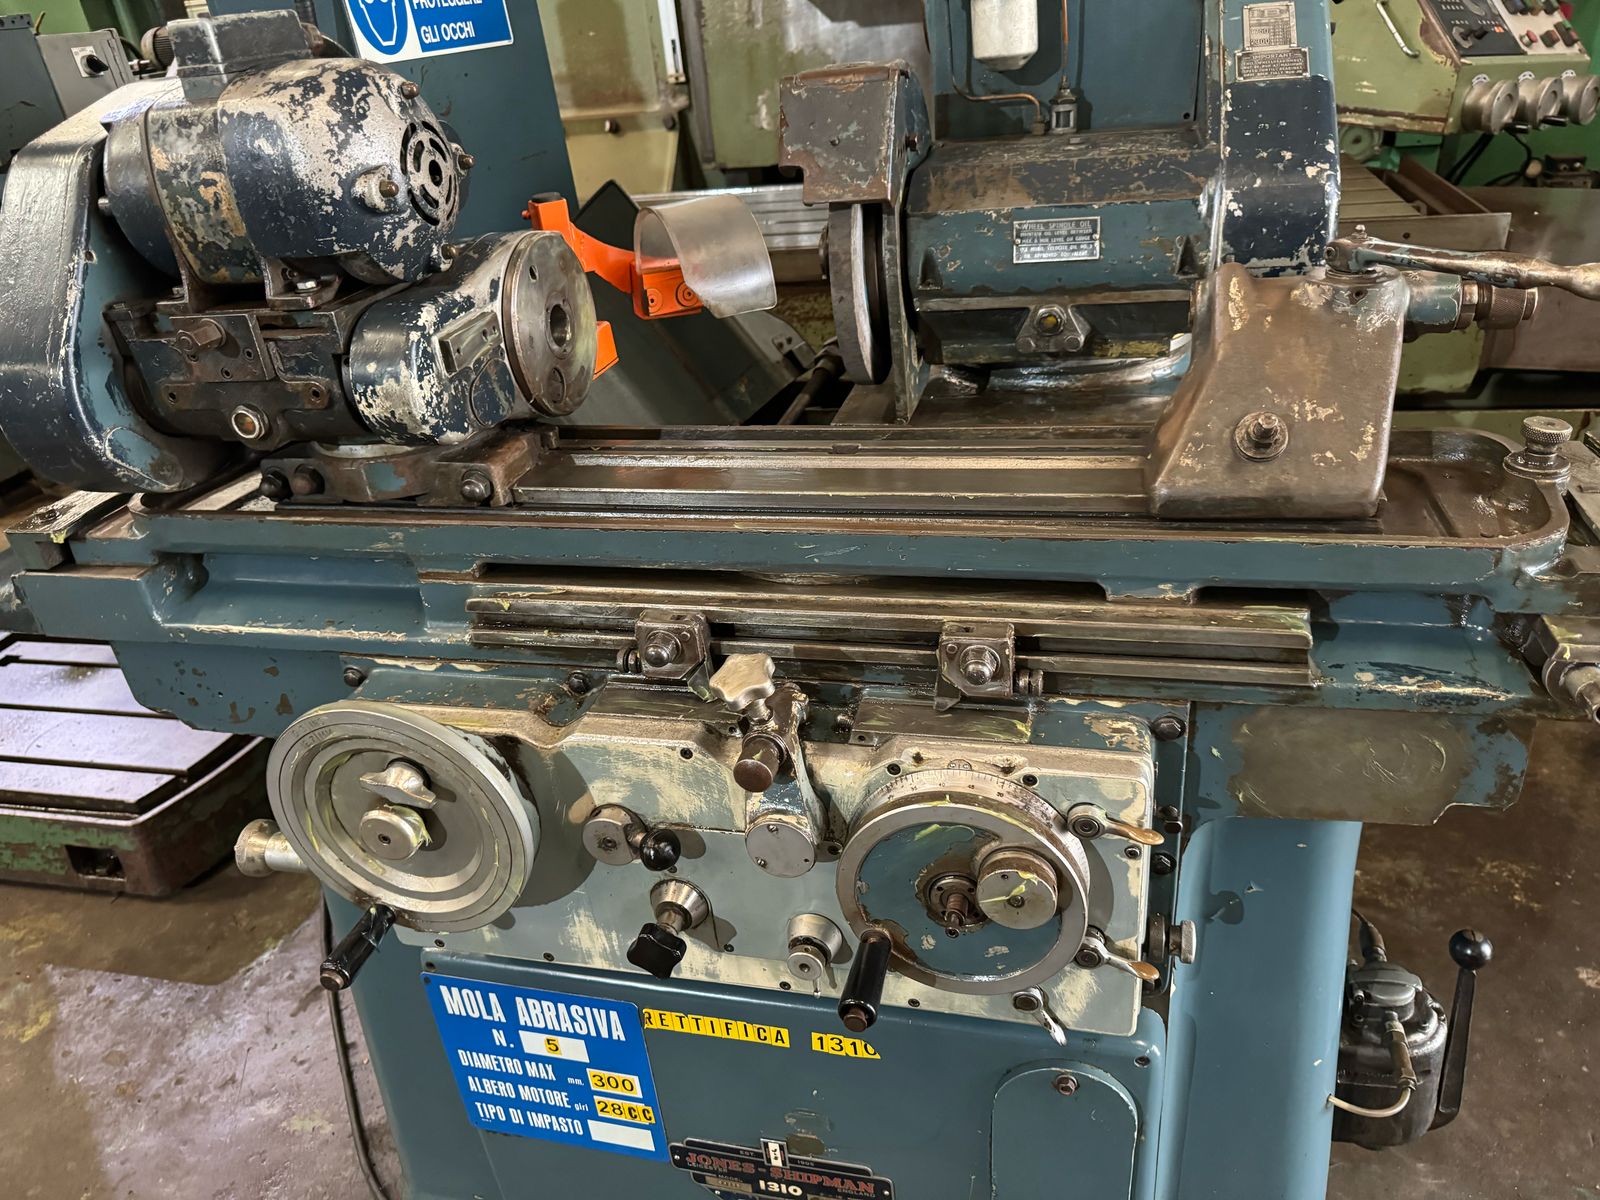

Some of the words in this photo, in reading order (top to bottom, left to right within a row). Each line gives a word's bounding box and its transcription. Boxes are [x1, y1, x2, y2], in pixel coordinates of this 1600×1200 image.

[420, 25, 440, 44] GLI
[441, 20, 476, 41] OCCHI
[1049, 221, 1076, 229] SPINDLE
[1080, 220, 1092, 228] OIL
[439, 985, 507, 1023] MOLA
[515, 996, 626, 1041] ABRASIVA
[644, 1011, 786, 1044] RETTIFICA
[491, 1028, 515, 1048] N.
[546, 1038, 560, 1052] 5
[457, 1048, 524, 1076] DIAMETRO
[524, 1060, 557, 1081] MAX
[567, 1077, 585, 1086] mm.
[592, 1074, 634, 1092] 300
[467, 1075, 516, 1099] ALBERO
[517, 1084, 571, 1108] MOTORE
[475, 1102, 506, 1121] TIPO
[508, 1107, 525, 1125] DI
[526, 1110, 584, 1136] IMPASTO
[686, 1152, 755, 1174] JONES
[769, 1165, 875, 1195] SHIPMAN
[759, 1179, 804, 1197] 1310
